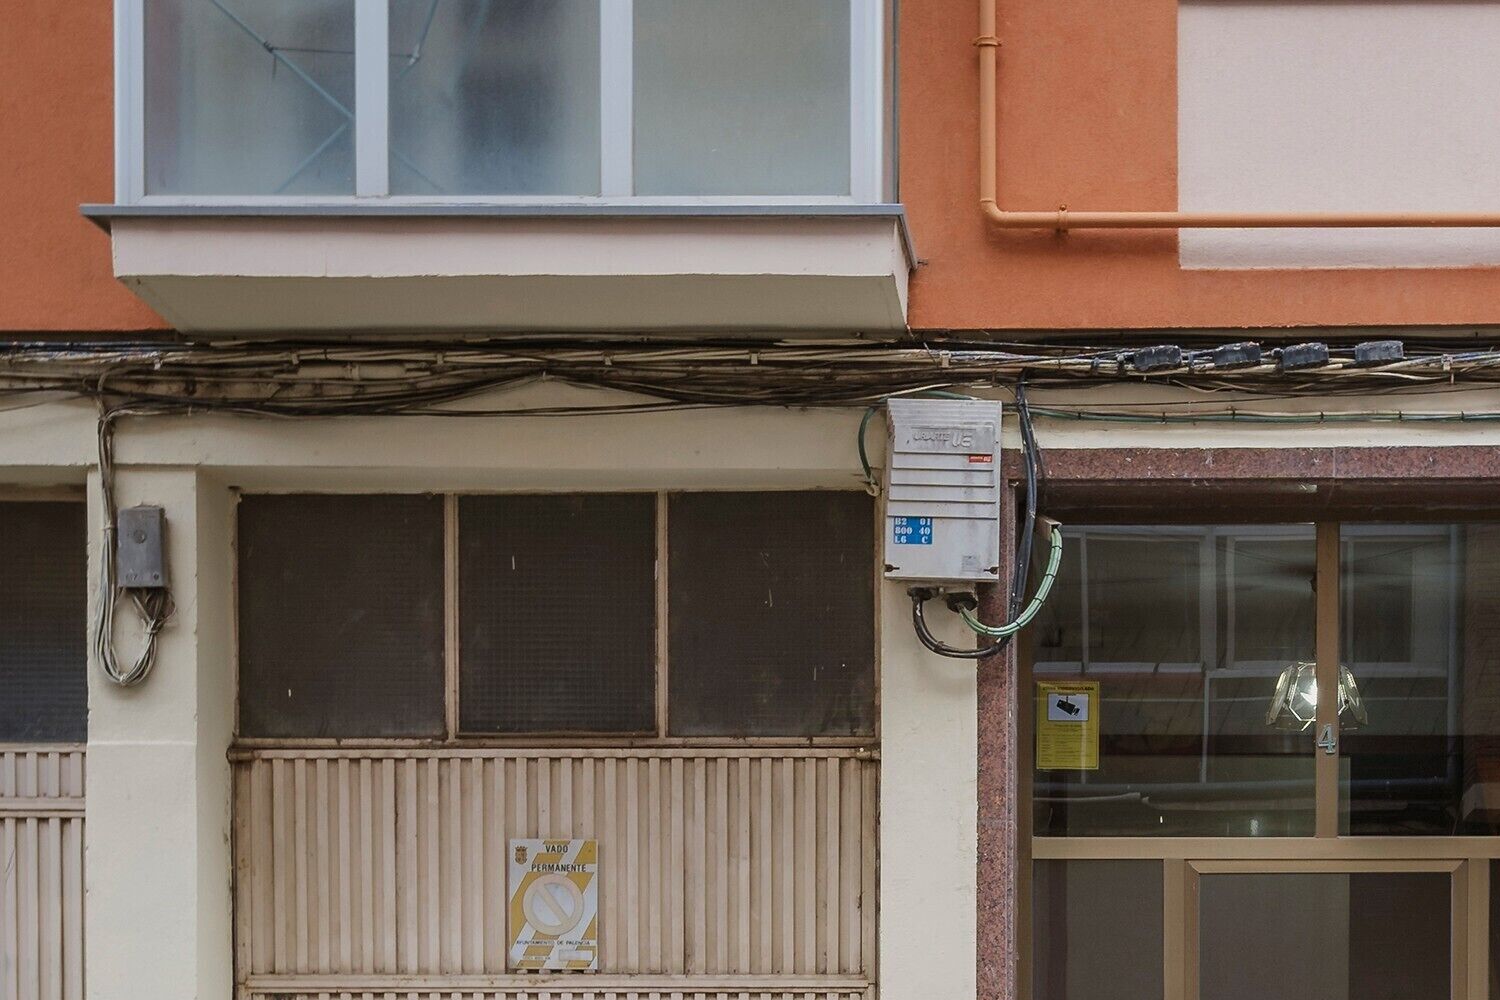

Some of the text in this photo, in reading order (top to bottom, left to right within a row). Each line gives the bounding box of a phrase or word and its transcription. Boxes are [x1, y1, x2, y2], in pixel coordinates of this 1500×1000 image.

[895, 526, 931, 535] 800 40
[921, 536, 929, 544] C
[1317, 723, 1336, 754] 4
[545, 844, 569, 854] VADO
[531, 863, 587, 873] PERMANENTE
